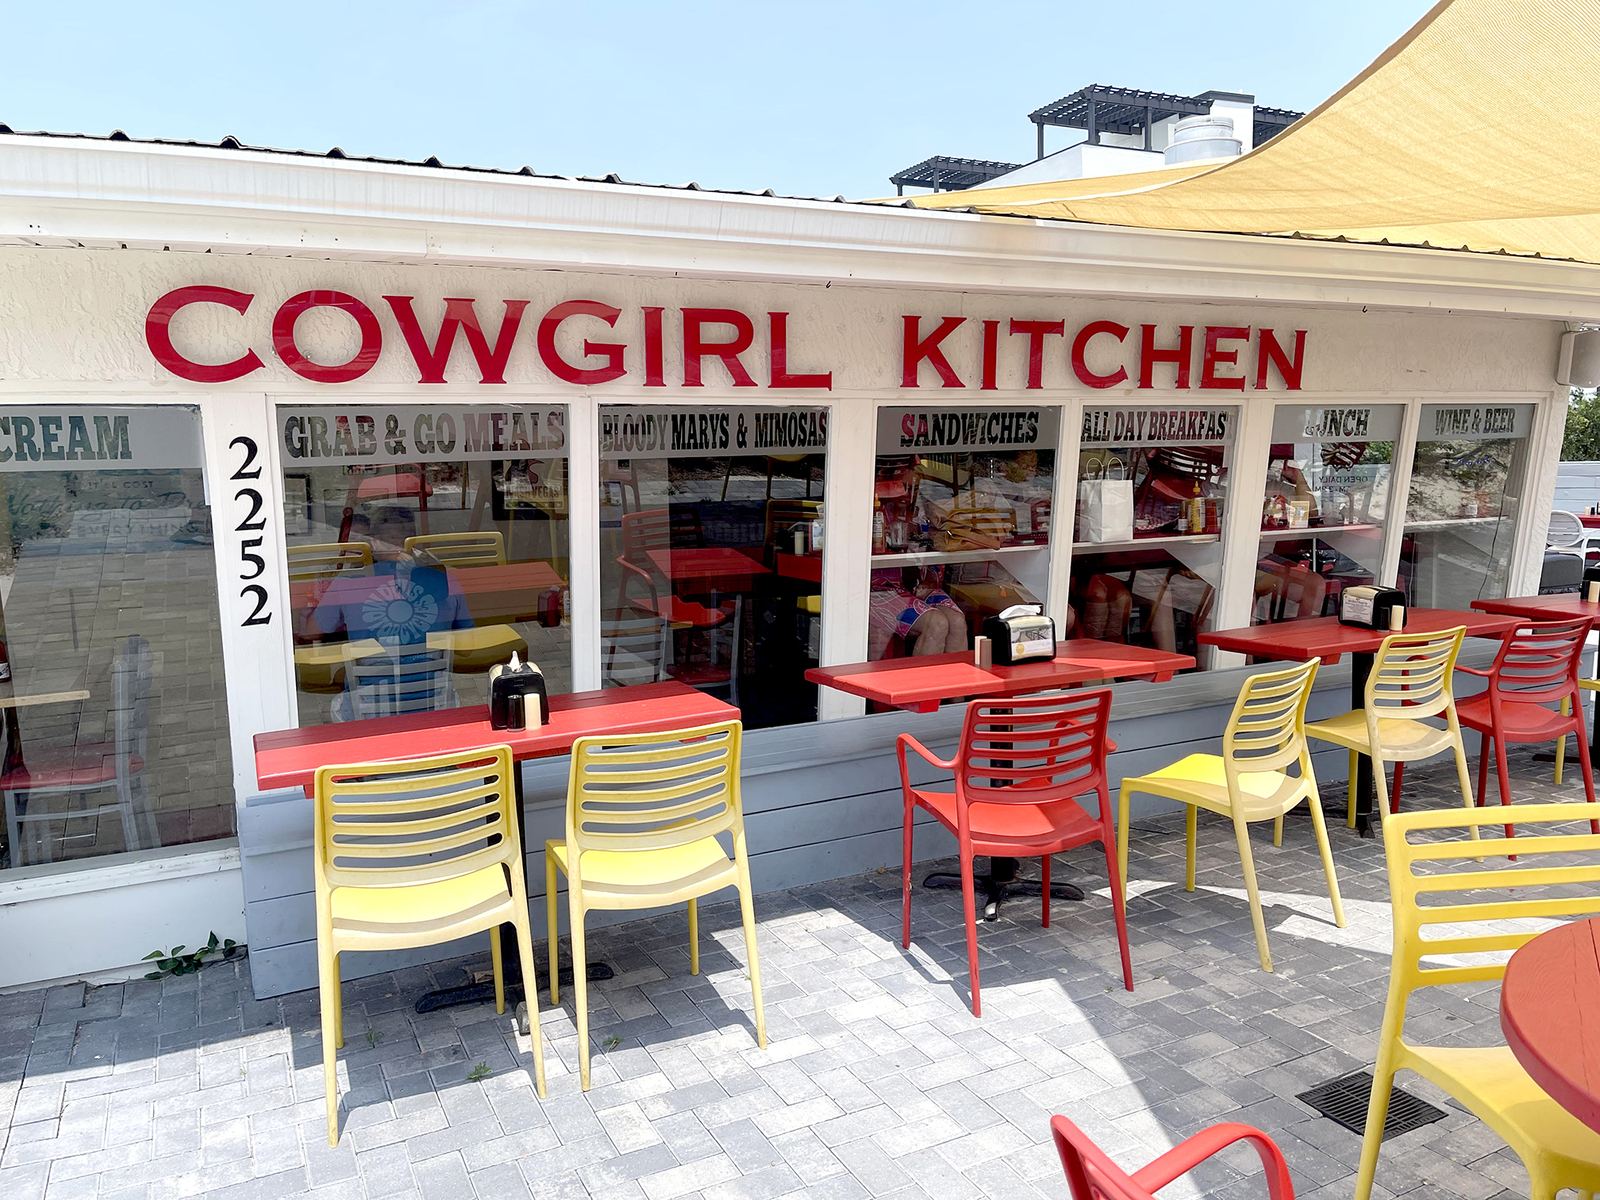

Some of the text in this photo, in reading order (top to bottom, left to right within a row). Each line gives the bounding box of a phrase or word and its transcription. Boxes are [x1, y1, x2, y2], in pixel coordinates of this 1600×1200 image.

[144, 285, 1308, 391] COWGIRL KITCHEN
[285, 410, 565, 458] GRAB & GO MEALS
[602, 410, 828, 453] BLOODY MARYS & MIMOSAS
[900, 412, 1040, 447] SANDWICHES
[1081, 411, 1111, 442] ALL
[1113, 411, 1147, 442] DAY
[1302, 409, 1371, 437] LUNCH
[1435, 408, 1516, 435] WINE & BEER
[229, 436, 272, 627] 2252
